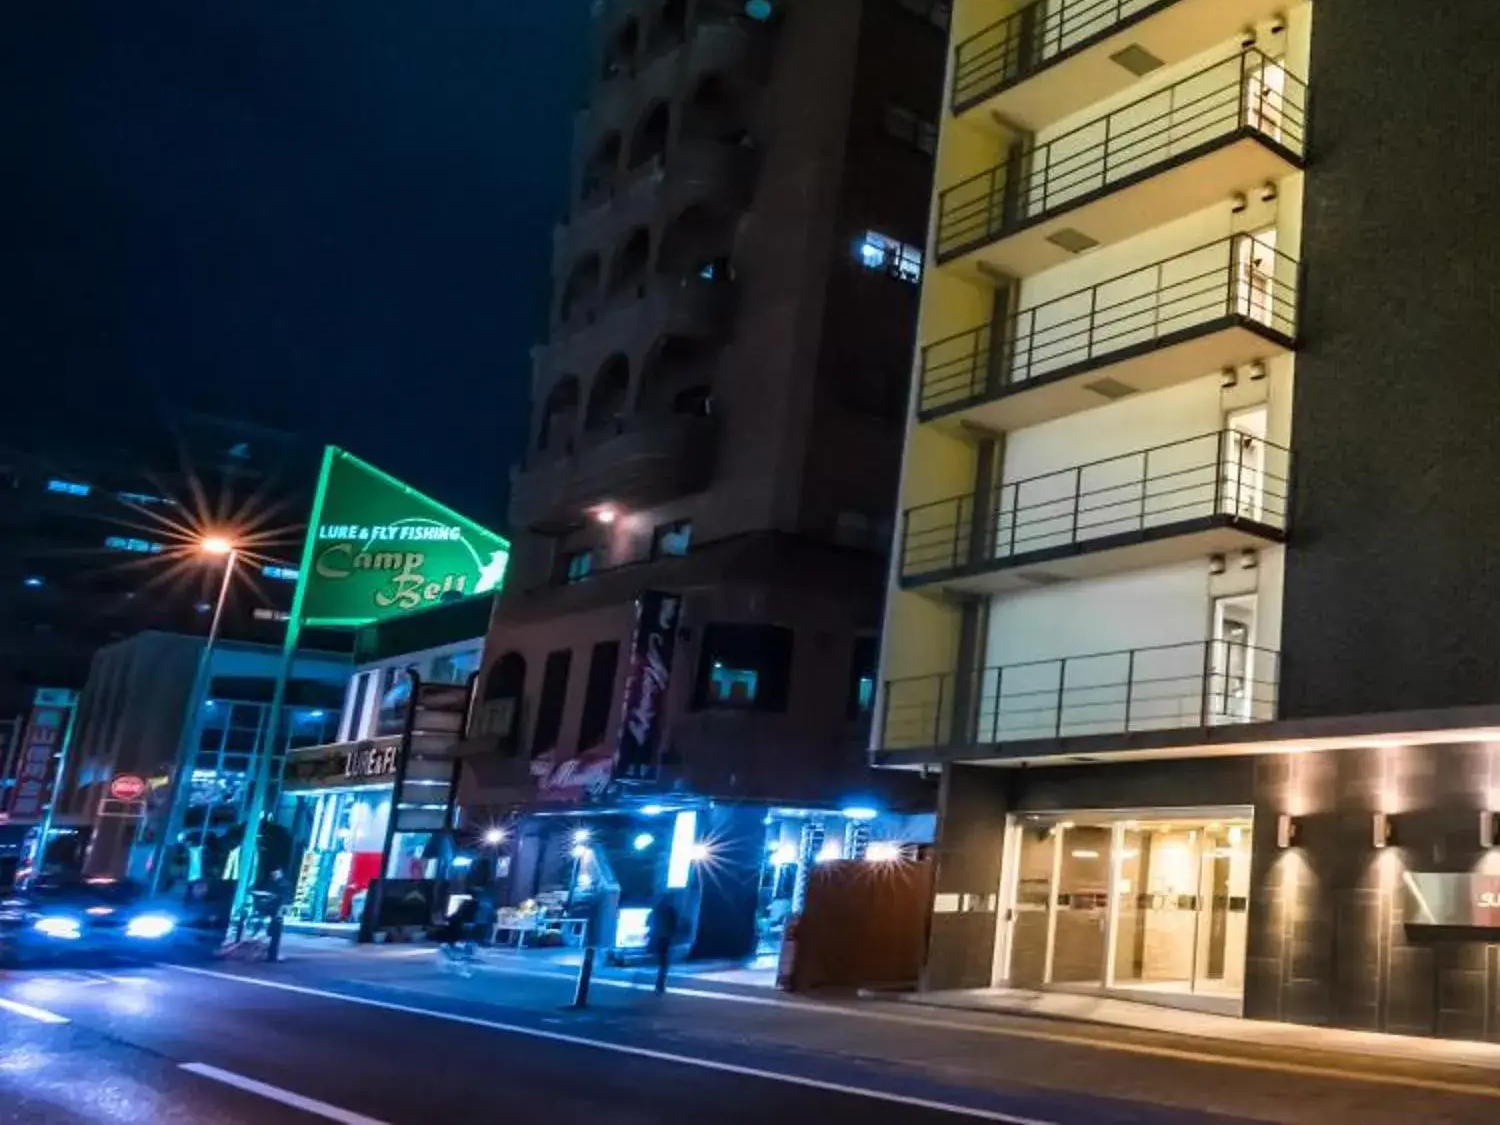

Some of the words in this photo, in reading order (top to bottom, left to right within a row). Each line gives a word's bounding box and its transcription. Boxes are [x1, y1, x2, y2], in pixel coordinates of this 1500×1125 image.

[371, 525, 400, 539] FLY
[400, 526, 461, 540] FISHING
[316, 543, 425, 578] Camp
